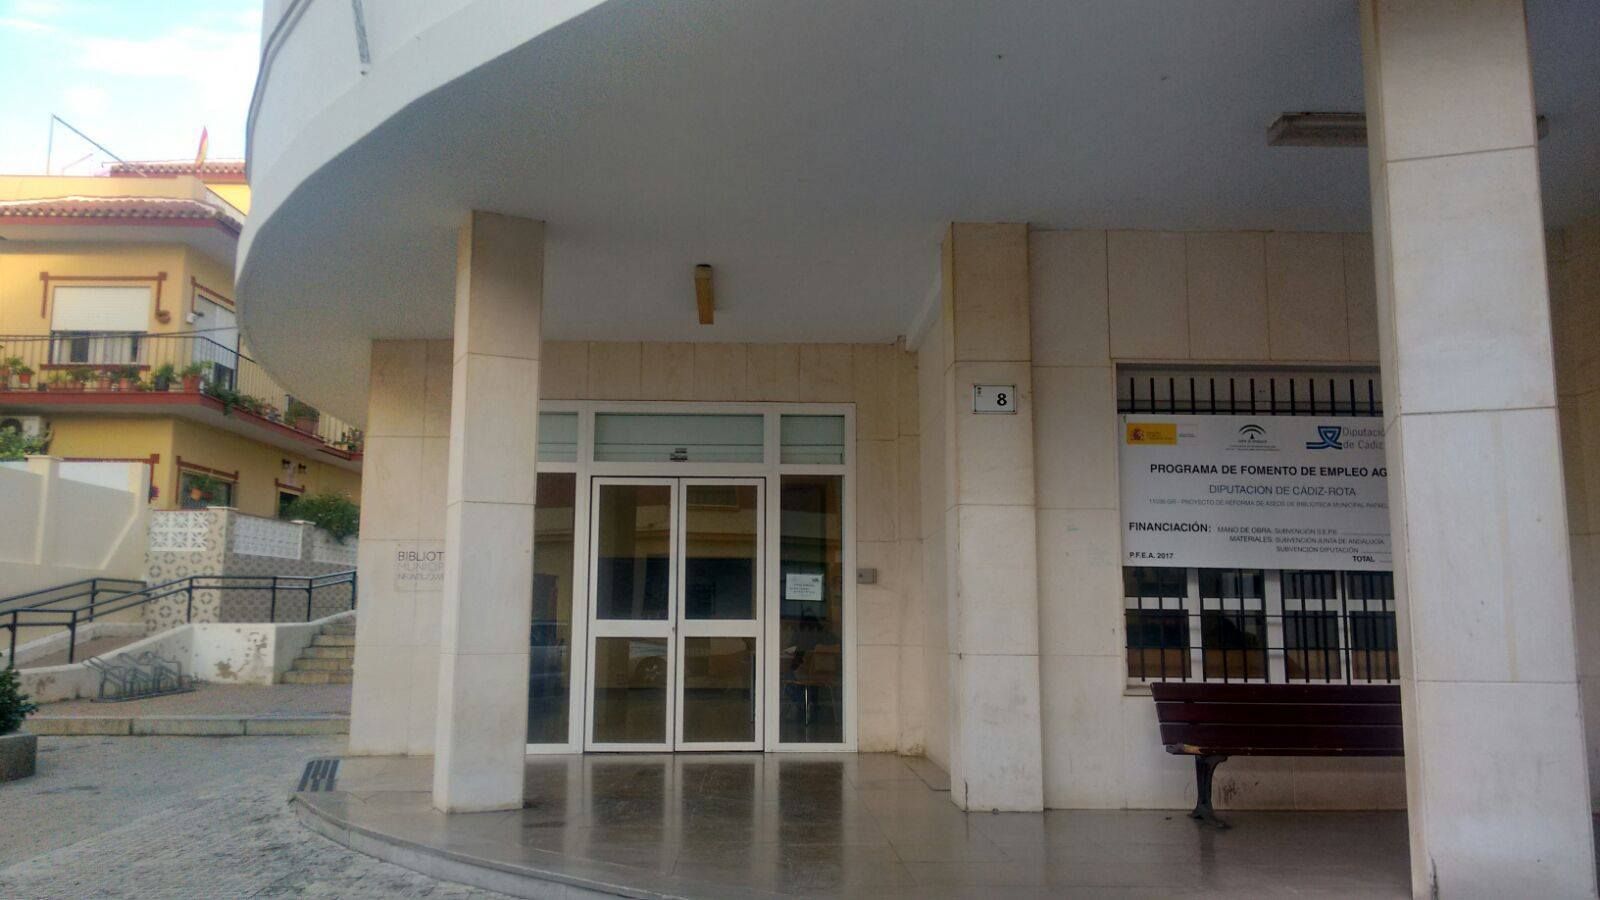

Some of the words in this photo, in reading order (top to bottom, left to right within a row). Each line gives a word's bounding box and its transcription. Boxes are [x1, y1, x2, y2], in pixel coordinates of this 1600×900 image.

[997, 392, 1007, 406] 8
[1150, 464, 1218, 474] PROGRAMA
[1221, 465, 1237, 474] DE
[1240, 465, 1298, 476] FOMENTO
[1301, 466, 1316, 476] DE
[1319, 467, 1368, 477] EMPLEO
[1371, 468, 1388, 478] AG
[1275, 486, 1290, 495] DE
[1129, 521, 1212, 533] FINANCIACIÓN:
[398, 551, 445, 561] BIBLIOT
